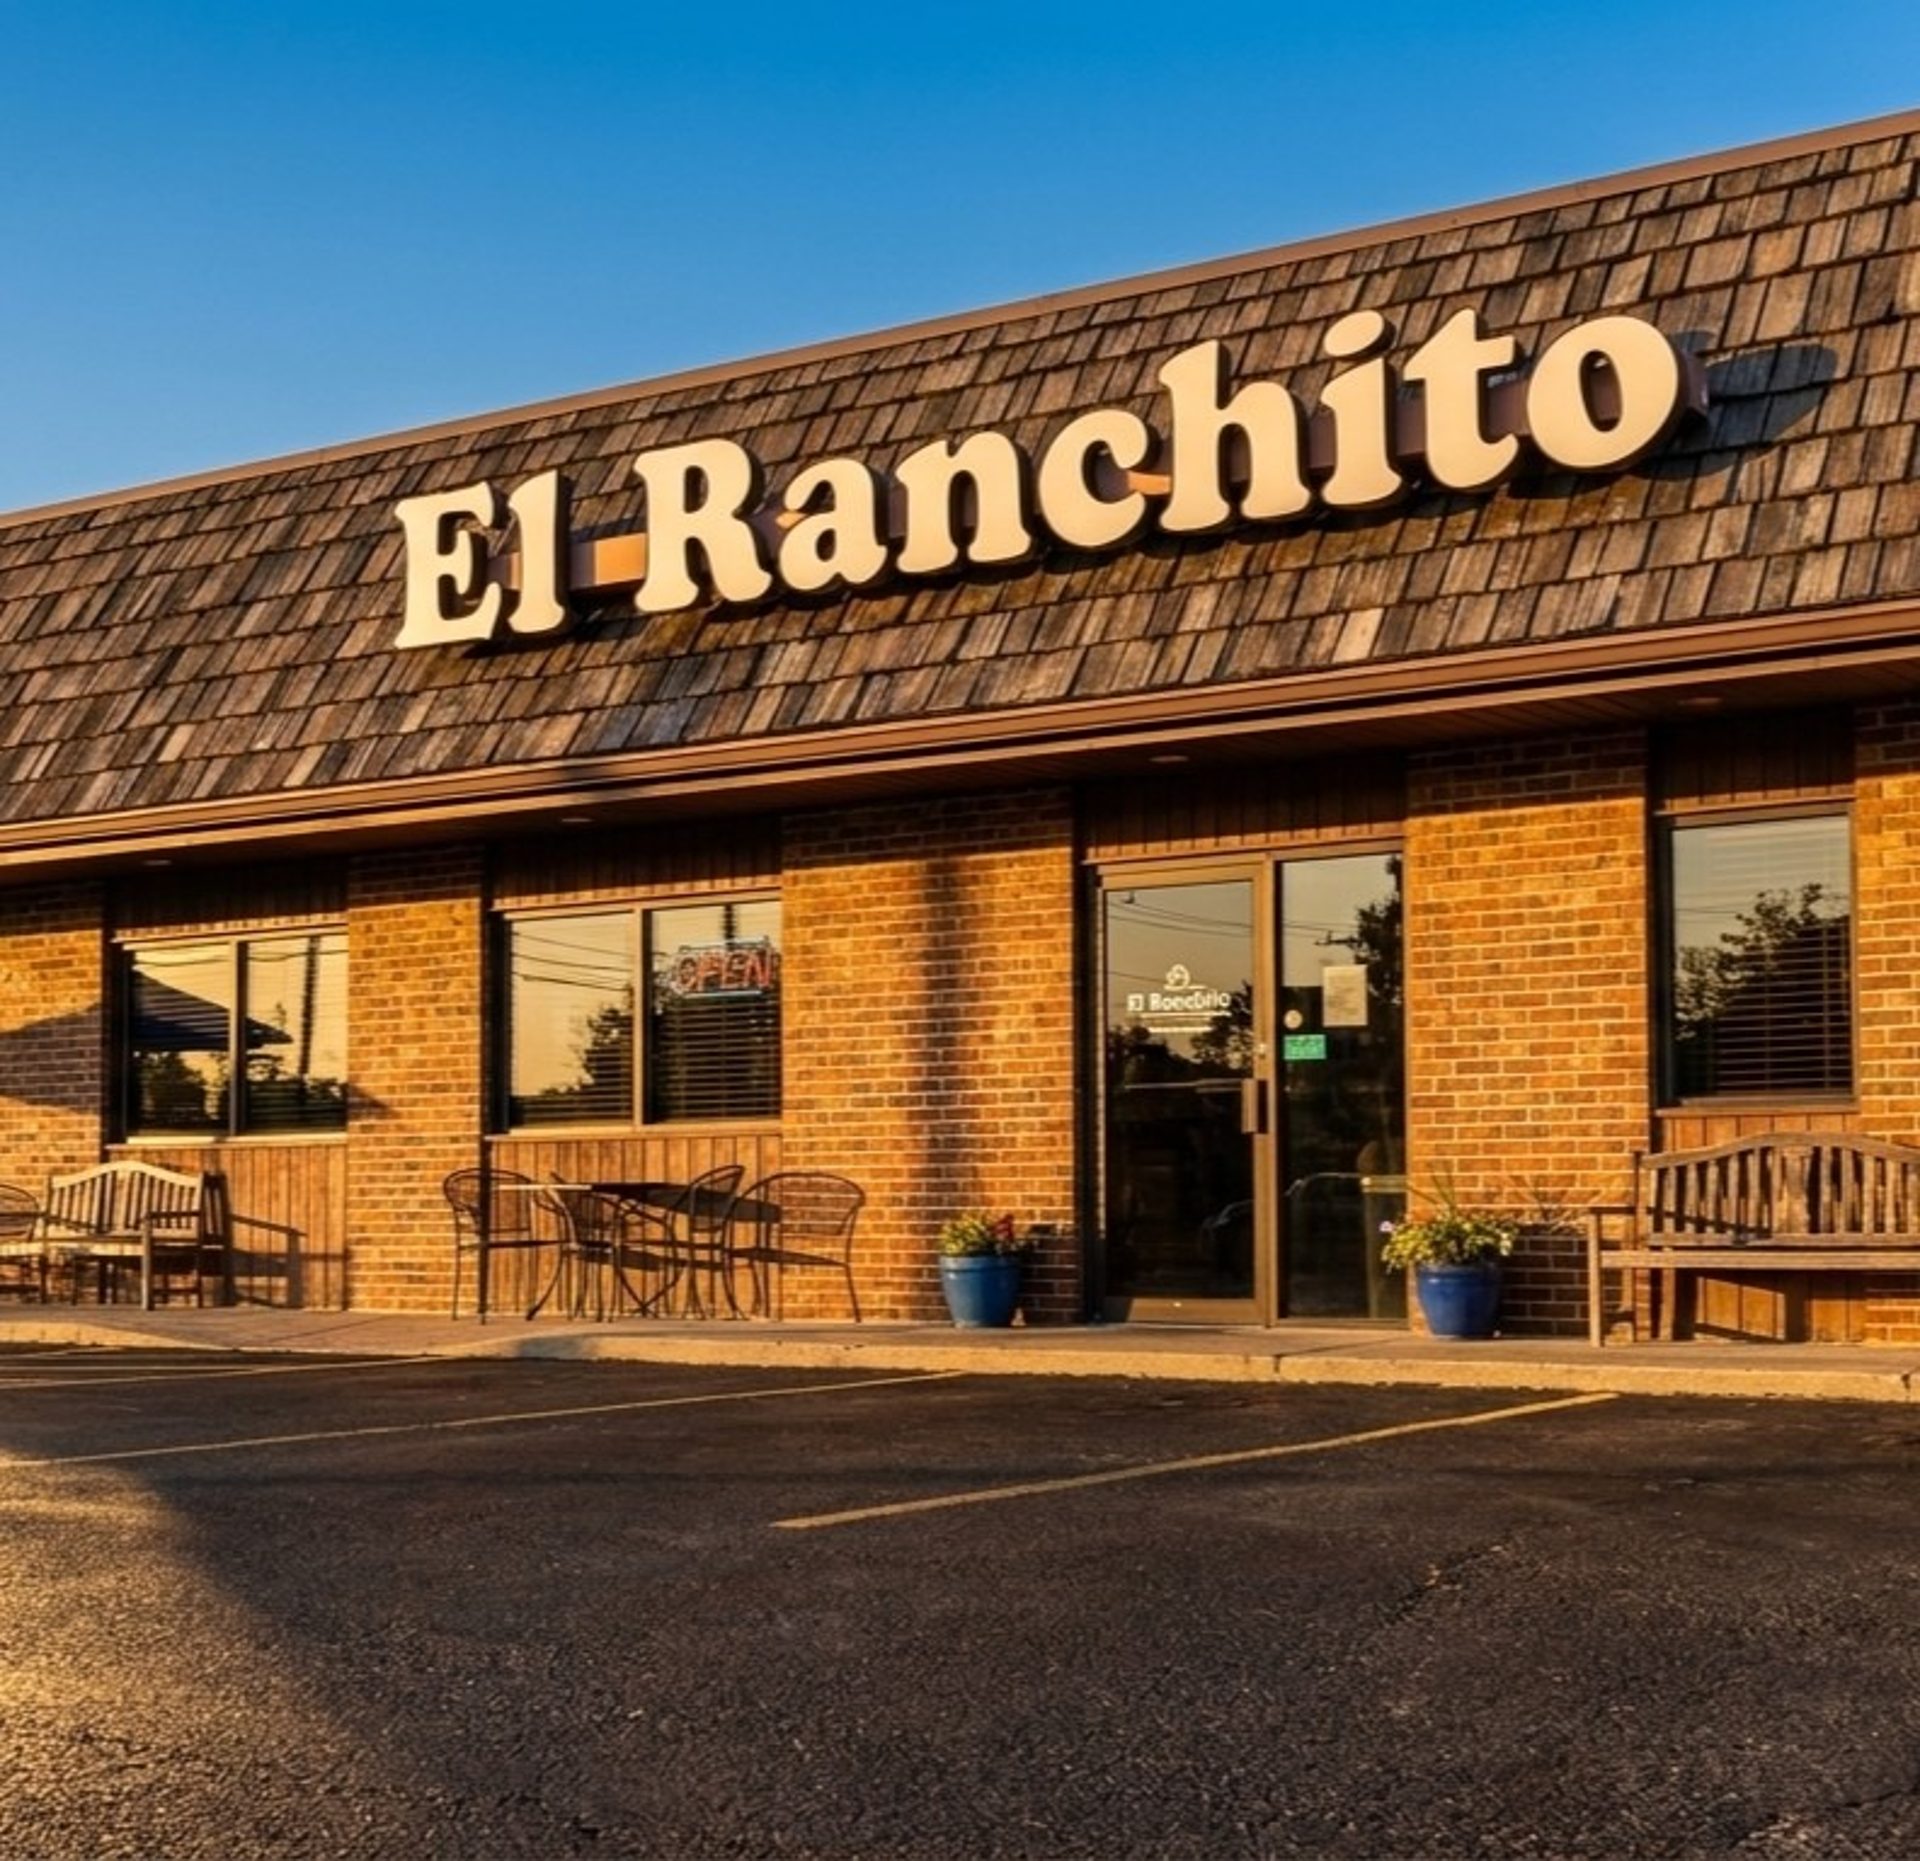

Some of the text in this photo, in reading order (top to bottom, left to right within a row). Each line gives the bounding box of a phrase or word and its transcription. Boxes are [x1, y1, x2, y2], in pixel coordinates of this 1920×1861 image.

[394, 309, 1679, 649] El Ranchito
[673, 948, 773, 994] OPEN
